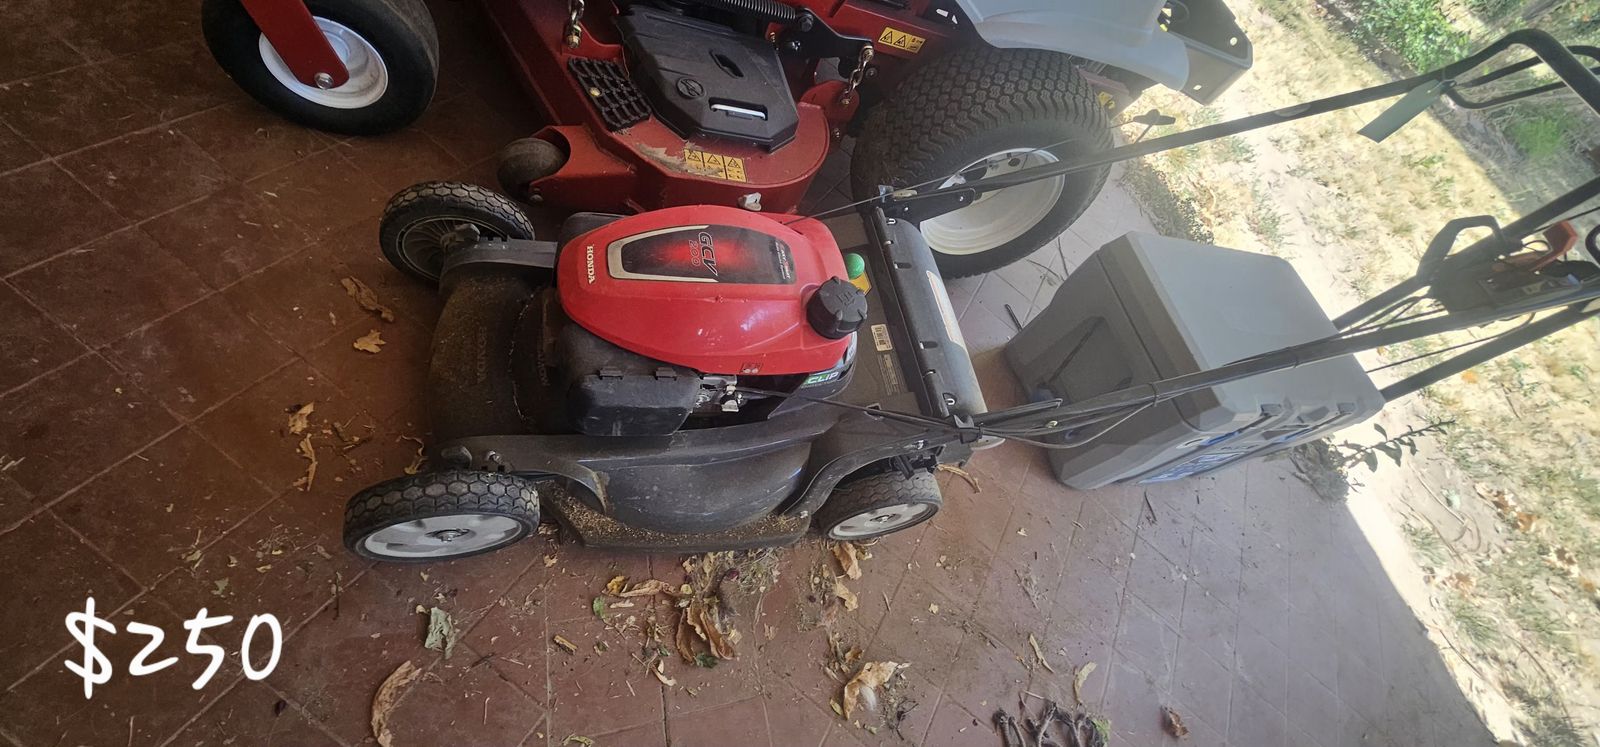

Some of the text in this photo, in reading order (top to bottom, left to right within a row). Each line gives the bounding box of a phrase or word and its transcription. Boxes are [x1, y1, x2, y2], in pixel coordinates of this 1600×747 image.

[586, 246, 596, 285] HONDA
[688, 240, 701, 267] 200
[698, 231, 719, 277] GCV
